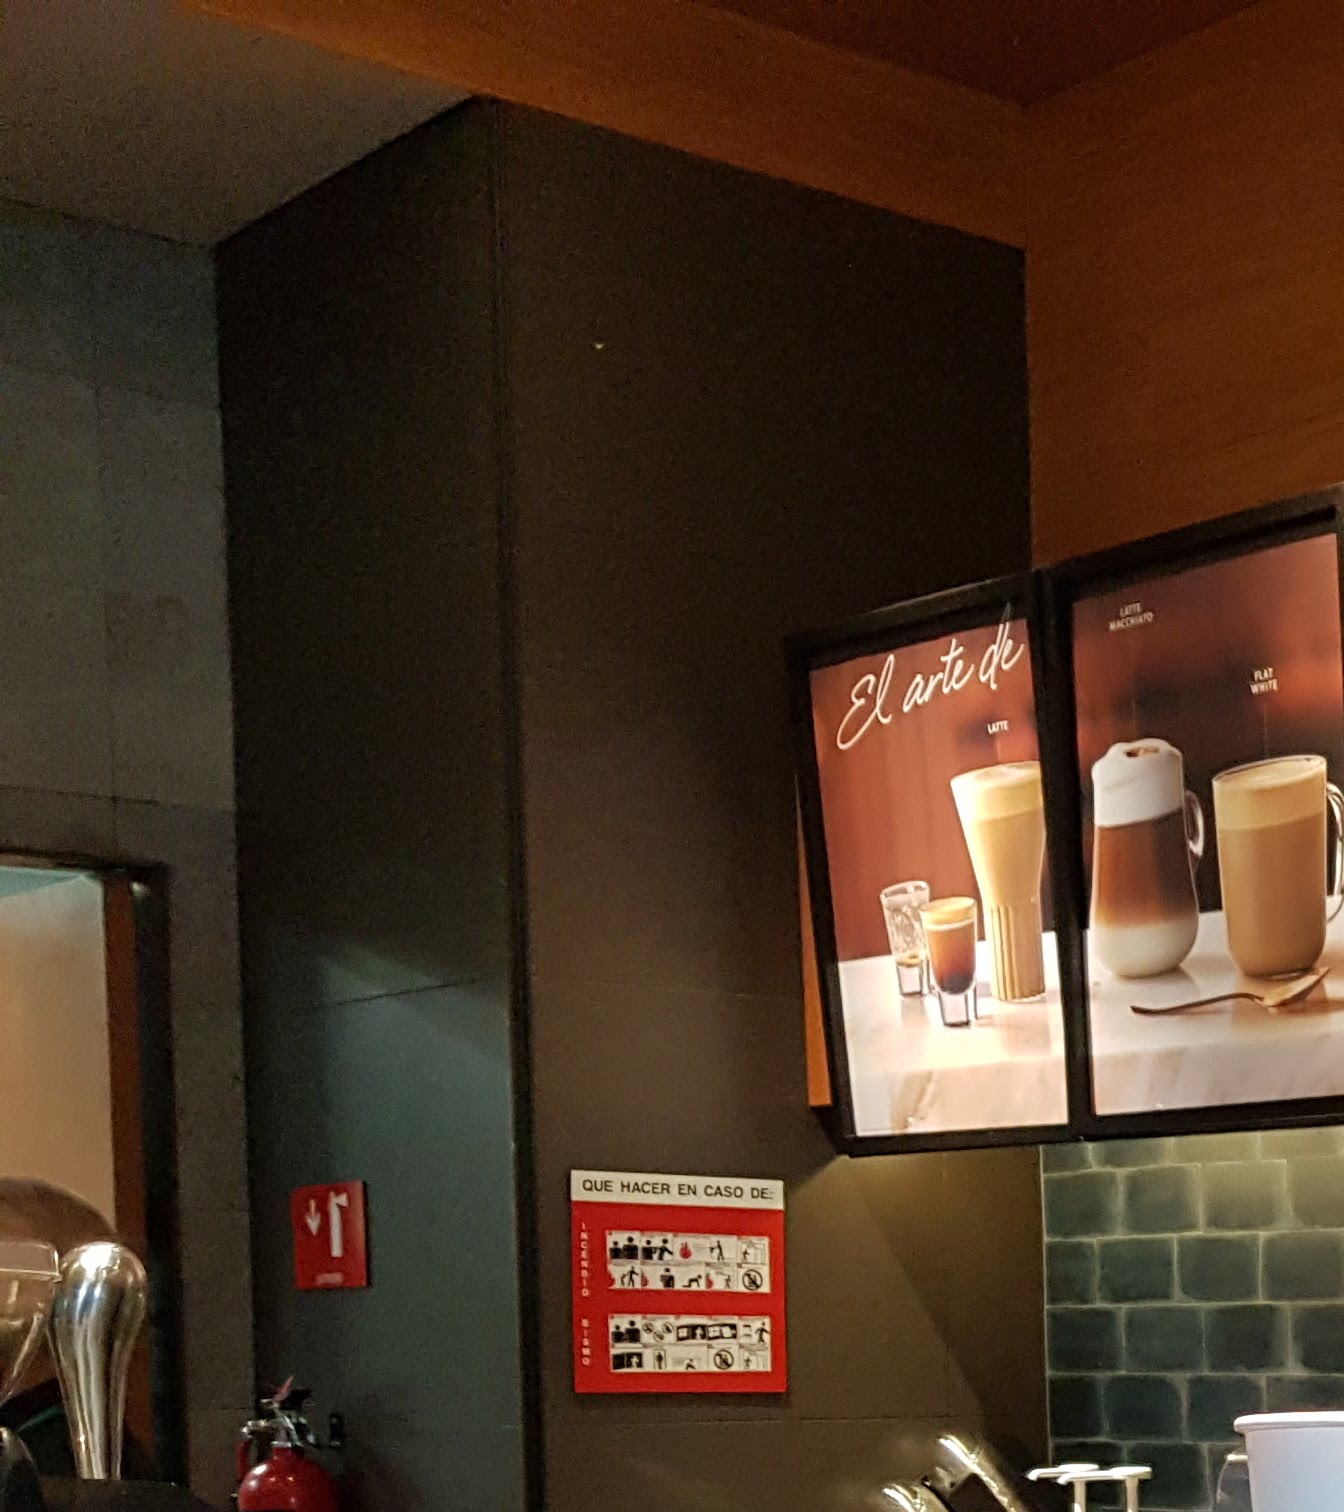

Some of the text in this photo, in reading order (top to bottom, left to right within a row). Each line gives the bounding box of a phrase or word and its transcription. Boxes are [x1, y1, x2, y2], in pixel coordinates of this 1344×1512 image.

[836, 653, 895, 750] El
[902, 638, 975, 713] arte
[582, 1178, 613, 1193] QUE
[620, 1181, 670, 1195] HACER
[678, 1183, 697, 1196] EN
[704, 1184, 744, 1199] CASO
